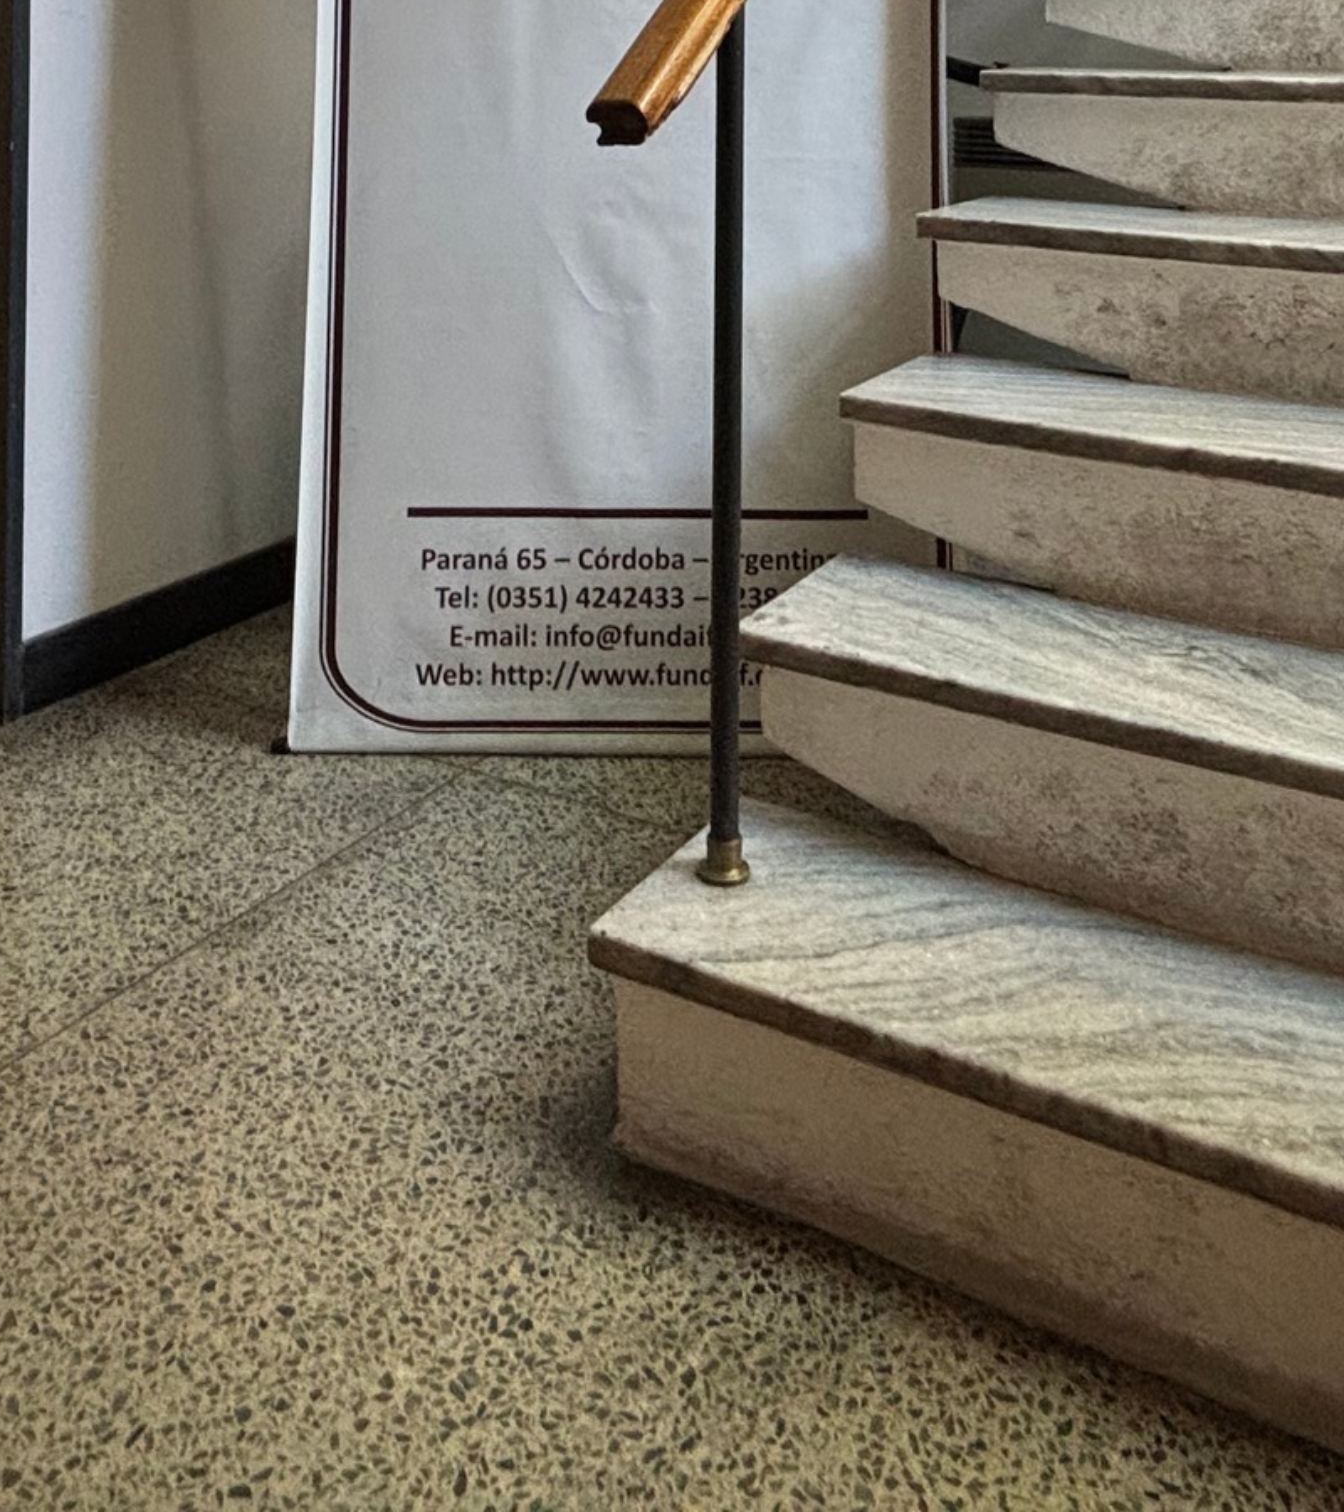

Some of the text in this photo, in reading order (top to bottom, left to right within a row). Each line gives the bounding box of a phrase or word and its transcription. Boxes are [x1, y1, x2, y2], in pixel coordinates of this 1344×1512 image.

[421, 547, 507, 571] Paraná
[516, 548, 547, 571] 65
[578, 546, 685, 571] Córdoba
[434, 586, 479, 609] Tel:
[487, 585, 568, 613] (0351)
[575, 586, 685, 609] 4242433
[449, 624, 712, 650] E-mail: info@fundai
[415, 662, 483, 686] Web:
